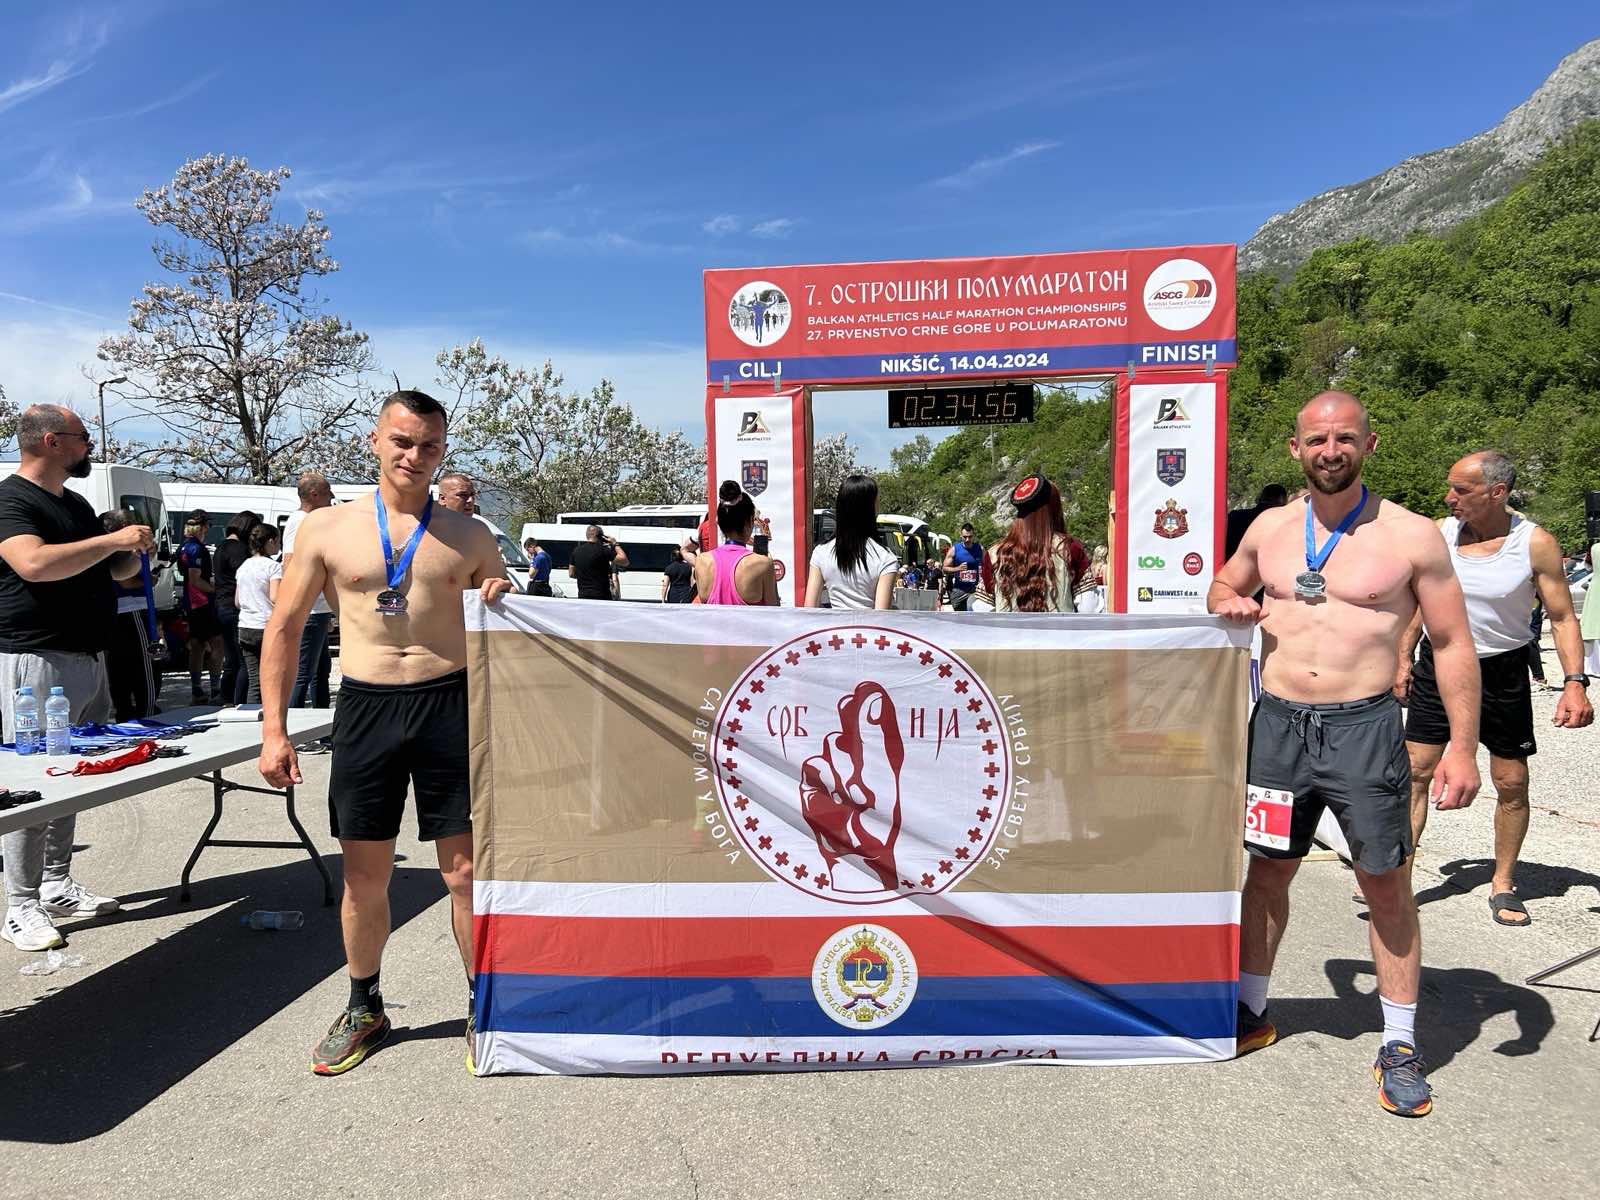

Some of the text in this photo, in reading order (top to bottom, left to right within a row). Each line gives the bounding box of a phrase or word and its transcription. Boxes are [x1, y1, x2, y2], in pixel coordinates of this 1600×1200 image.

[805, 269, 1128, 306] 7. ОСТРОШКИ ПОЛУМАРАТОН
[1153, 291, 1184, 300] ASCG
[807, 302, 1127, 325] BALKAN ATHLETICS HALF MARATHON CHAMPIONSHIPS
[807, 316, 1128, 341] 27. PRVENSTVO CRNE GORE U POLUMARATONU
[880, 352, 1049, 373] NIKŠIĆ, 14.04.2024
[1142, 344, 1217, 363] FINISH
[739, 361, 782, 378] CILJ
[700, 687, 722, 712] СА
[692, 715, 710, 782] ВЕРОМ
[1003, 775, 1031, 838] СВЕТУ
[705, 811, 741, 865] БОГА
